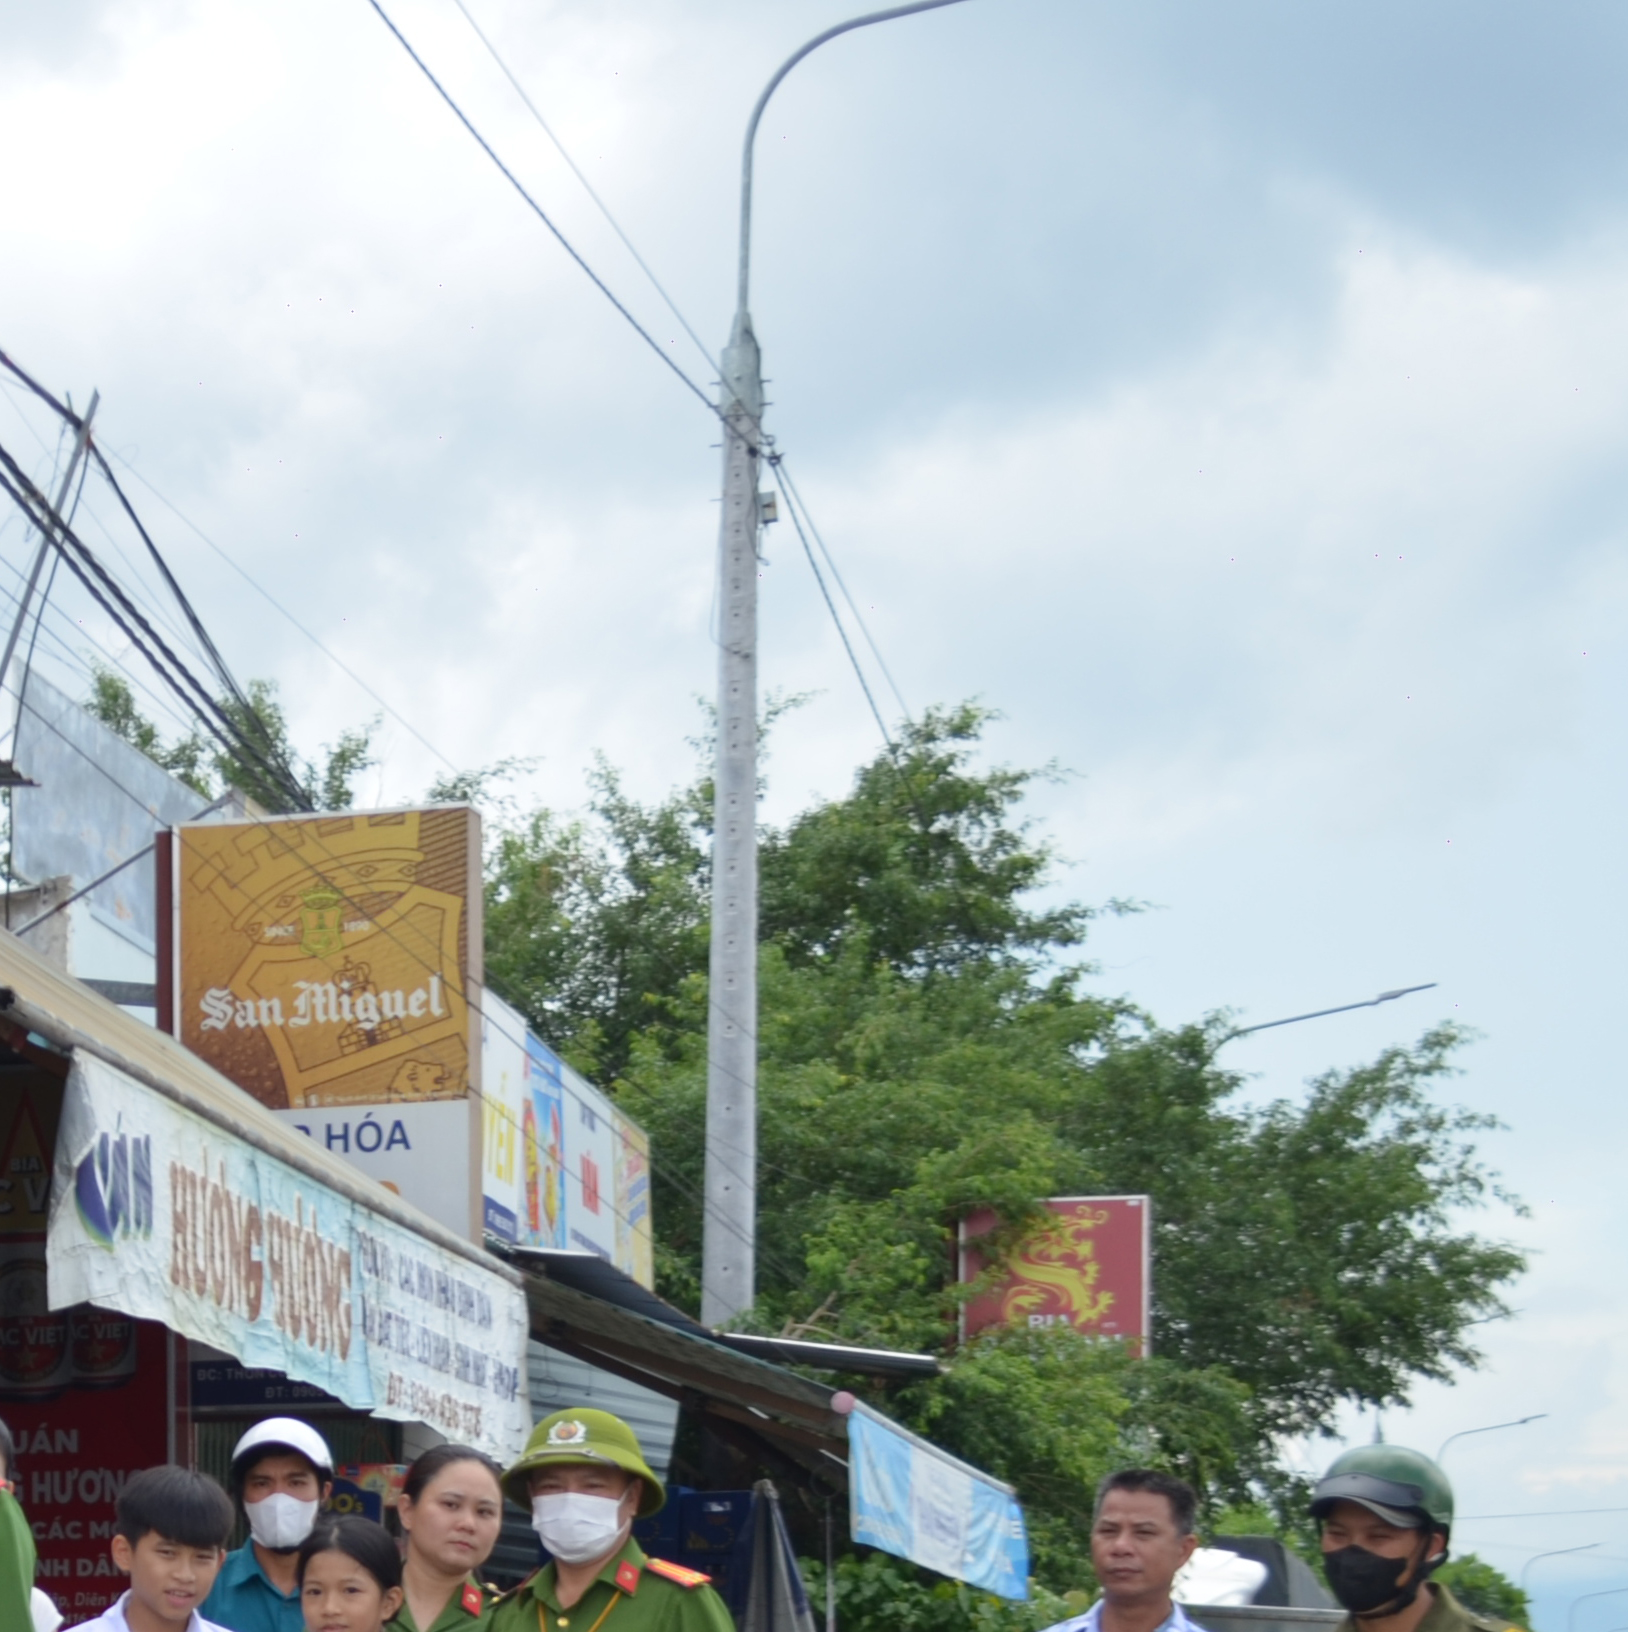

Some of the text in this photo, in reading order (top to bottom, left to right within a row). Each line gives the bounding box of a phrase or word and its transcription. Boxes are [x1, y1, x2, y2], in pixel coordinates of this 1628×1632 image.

[199, 972, 444, 1031] San Miguel
[325, 1111, 412, 1153] HÓA
[9, 1157, 41, 1173] BIA
[10, 1422, 79, 1453] UÁN
